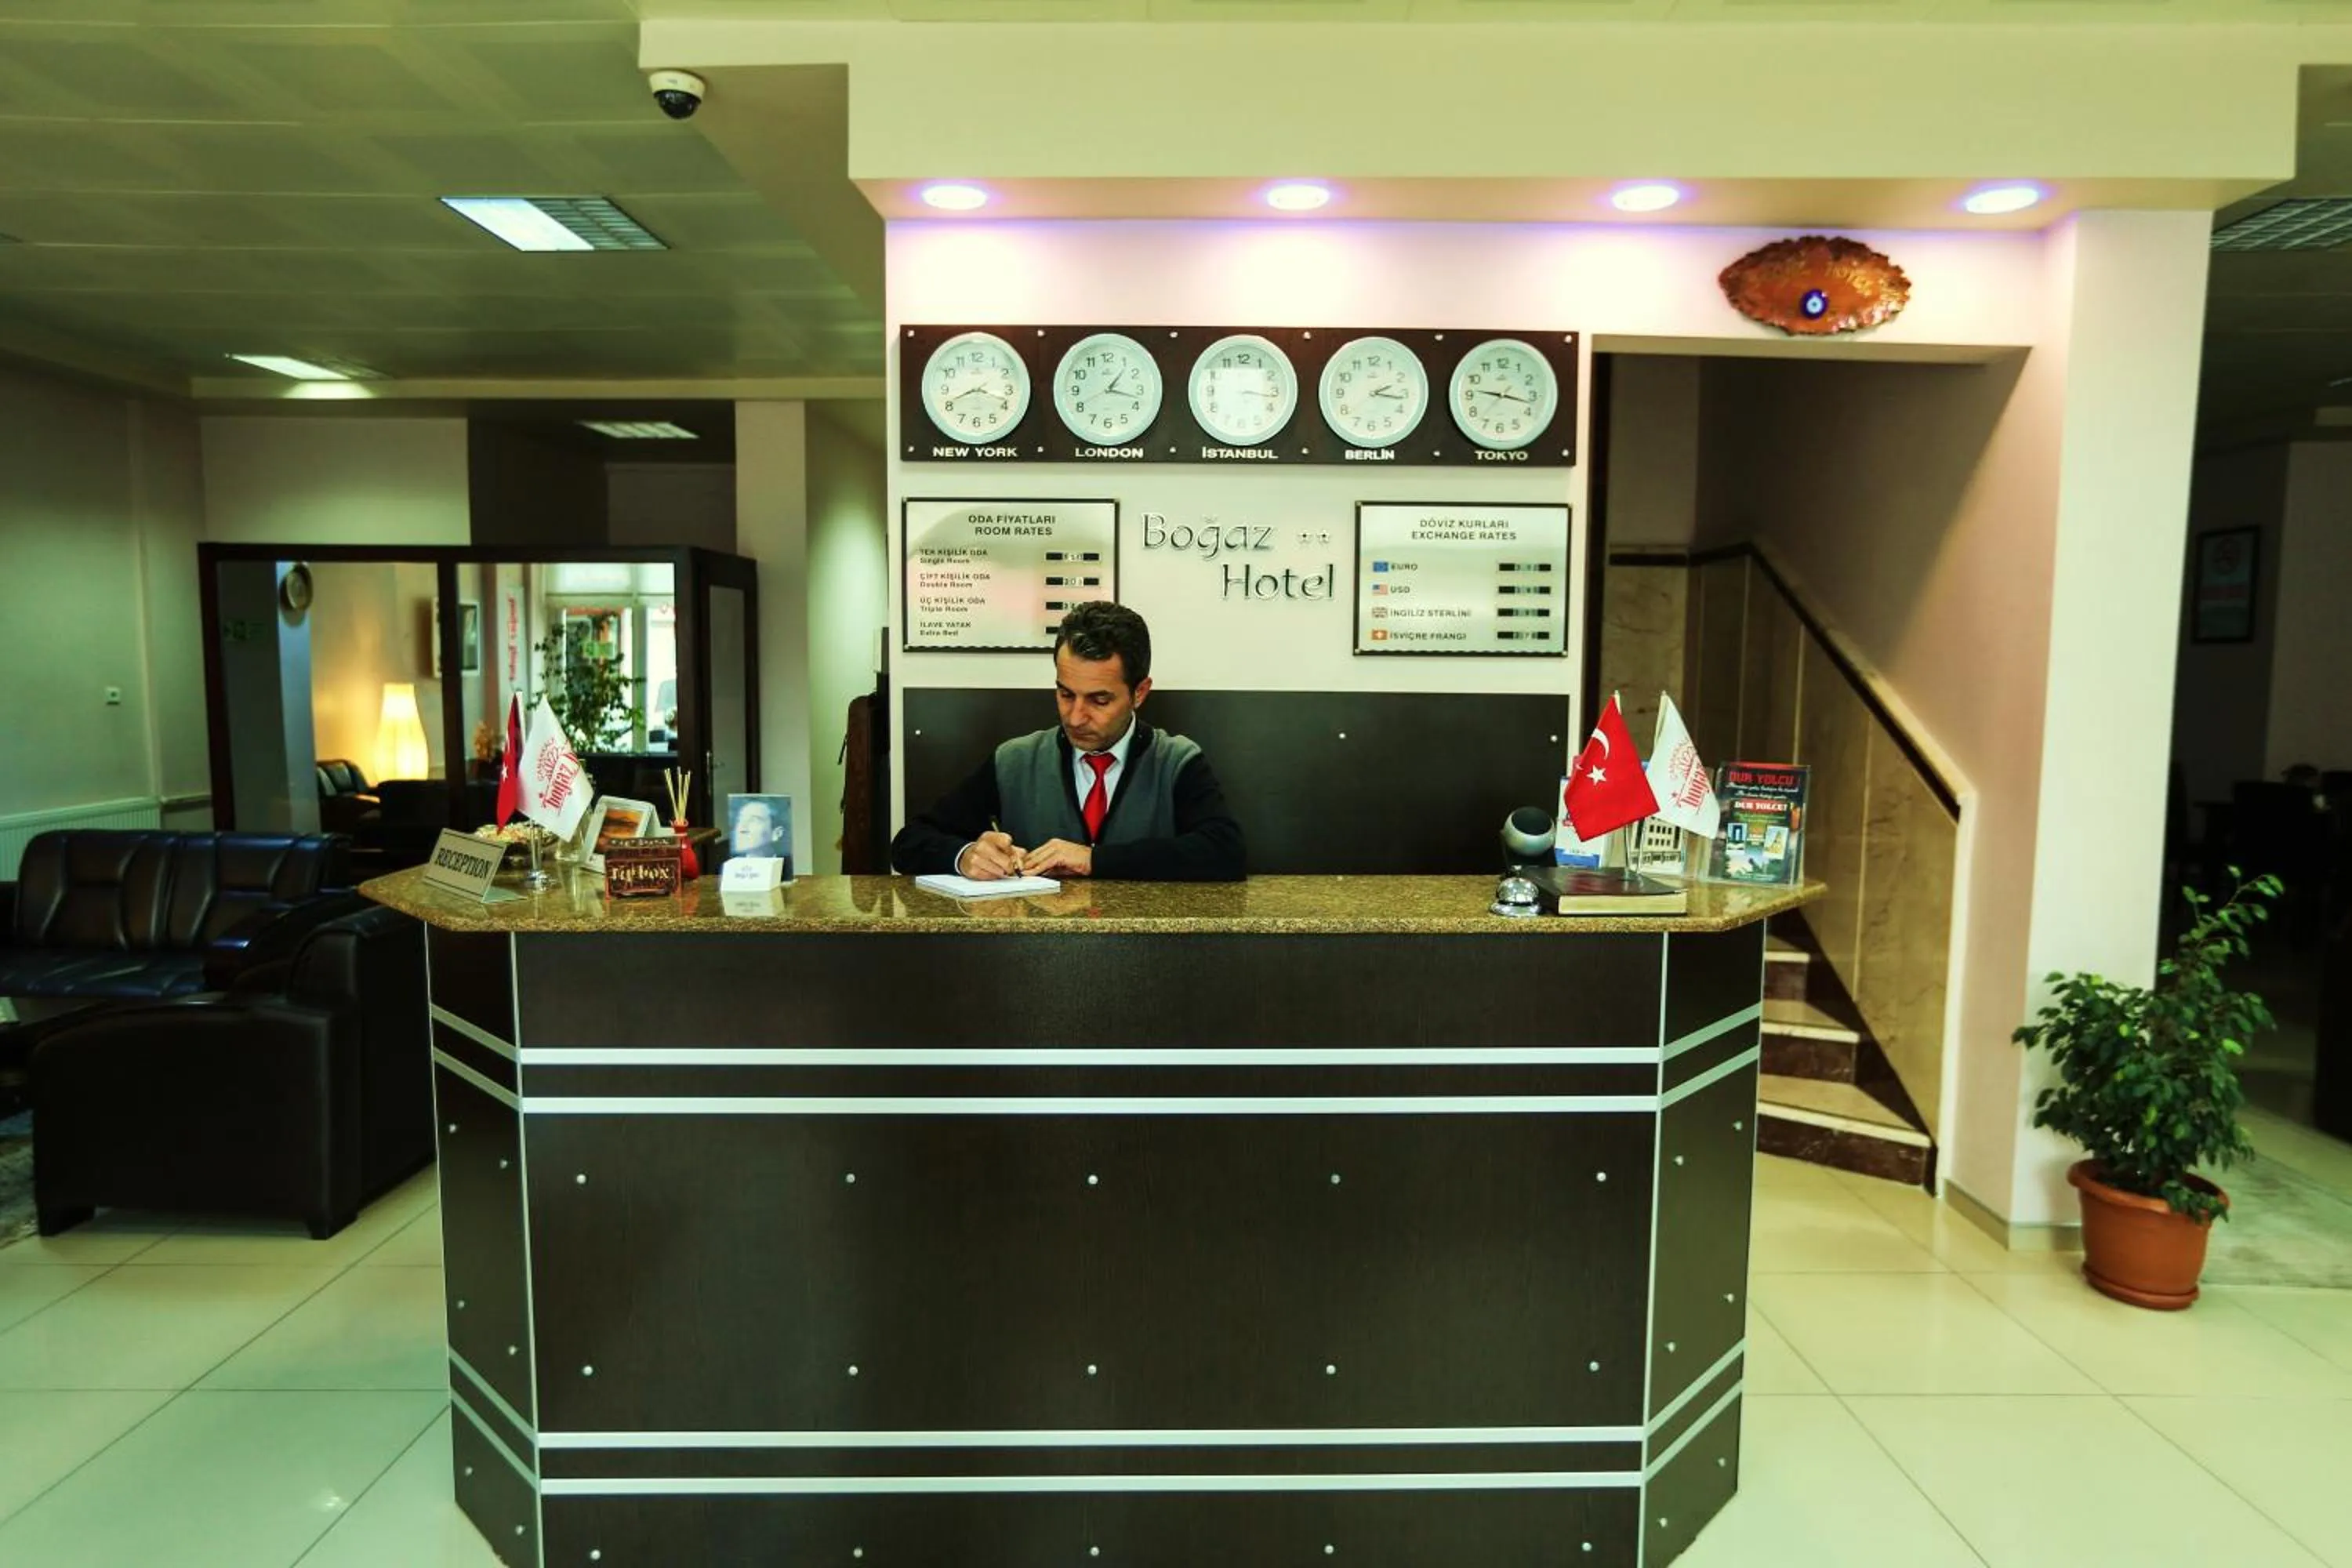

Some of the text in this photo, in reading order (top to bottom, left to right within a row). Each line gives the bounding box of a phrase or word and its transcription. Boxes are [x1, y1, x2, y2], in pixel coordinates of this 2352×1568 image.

[971, 352, 984, 362] 12
[1101, 353, 1113, 363] 12
[1237, 354, 1250, 364] 12
[1367, 356, 1380, 366] 12
[956, 357, 964, 368] 11
[1087, 358, 1094, 367] 11
[1221, 358, 1231, 368] 11
[1352, 360, 1361, 370] 11
[1481, 362, 1490, 372] 11
[1497, 358, 1509, 368] 12
[943, 368, 956, 379] 10
[1002, 368, 1009, 379] 2
[1073, 369, 1087, 379] 10
[1131, 368, 1139, 379] 2
[1268, 370, 1276, 380] 2
[1338, 372, 1352, 383] 10
[1396, 372, 1405, 383] 2
[1468, 374, 1480, 384] 10
[1525, 374, 1534, 386] 2
[941, 385, 949, 395] 9
[1005, 385, 1013, 395] 3
[1071, 386, 1080, 396] 9
[1136, 385, 1144, 395] 3
[1270, 387, 1279, 397] 3
[1336, 388, 1345, 398] 9
[1465, 390, 1474, 401] 9
[1529, 390, 1537, 401] 3
[946, 401, 953, 412] 8
[1000, 400, 1008, 410] 4
[1076, 402, 1083, 412] 8
[1132, 401, 1139, 411] 4
[1340, 405, 1348, 415] 8
[1395, 404, 1403, 414] 4
[1469, 406, 1477, 417] 8
[1524, 408, 1531, 416] 4
[957, 414, 966, 423] 7
[972, 417, 980, 427] 6
[989, 413, 996, 424] 5
[1089, 414, 1097, 424] 7
[1104, 418, 1112, 429] 6
[1120, 414, 1128, 424] 5
[1353, 416, 1361, 426] 7
[1384, 416, 1392, 427] 5
[1367, 420, 1376, 431] 6
[1482, 419, 1490, 429] 7
[1495, 423, 1504, 433] 6
[1512, 419, 1520, 430] 5
[933, 447, 1018, 457] NEW YORK
[1075, 448, 1144, 459] LONDON
[1202, 446, 1278, 459] İSTANBUL
[1345, 449, 1395, 460] BERLİN
[1475, 450, 1528, 461] TOKYO
[968, 514, 1056, 524] ODA FİYATLARI
[1420, 517, 1456, 528] DÖVİZ
[975, 526, 1053, 535] ROOM RATES
[1411, 531, 1517, 540] EXCHANGE RATES
[1142, 512, 1273, 561] Boğaz
[1221, 563, 1335, 600] Hotel
[435, 848, 492, 880] RECEPTION
